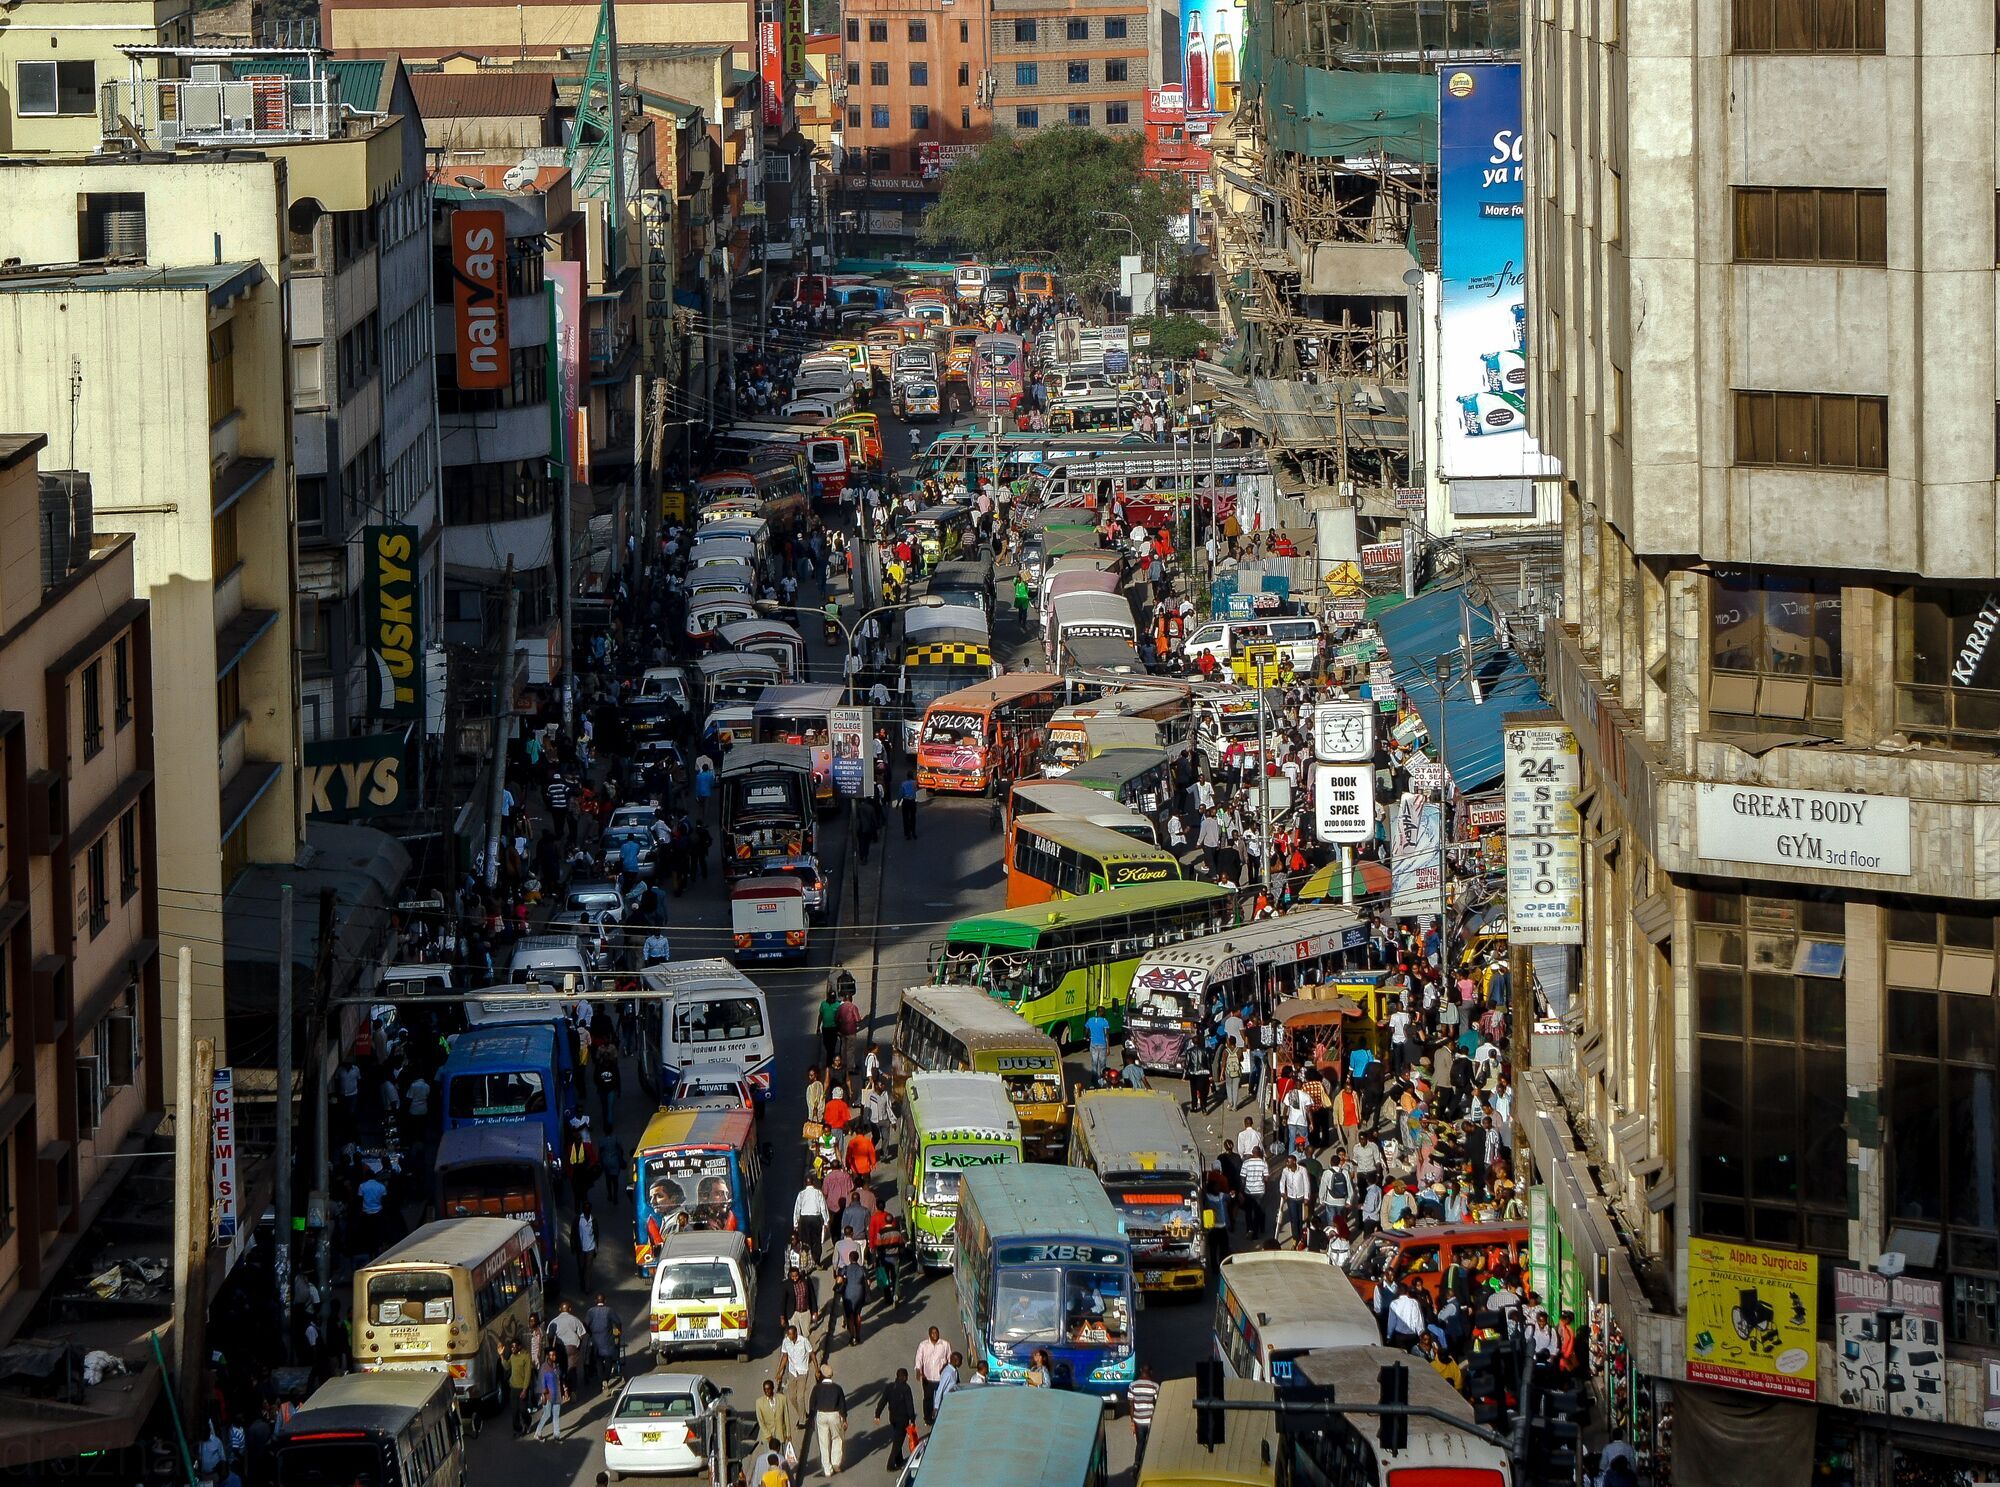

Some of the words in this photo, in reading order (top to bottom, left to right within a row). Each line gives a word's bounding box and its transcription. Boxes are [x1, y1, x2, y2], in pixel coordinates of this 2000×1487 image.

[1482, 168, 1508, 187] ya
[902, 179, 923, 188] PLAZA
[1485, 206, 1508, 215] More
[454, 227, 498, 373] naivas
[1229, 602, 1249, 610] THIKA
[378, 533, 414, 704] TUSKYS
[1067, 628, 1131, 638] MARTIAL
[927, 715, 982, 730] XPLORA
[1519, 757, 1556, 778] 24
[1331, 777, 1357, 787] BOOK
[1333, 790, 1355, 801] THIS
[1330, 805, 1360, 815] SPACE
[1733, 792, 1805, 820] GREAT
[1811, 799, 1869, 826] BODY
[1324, 819, 1339, 827] 0700
[1341, 819, 1352, 827] 060
[1354, 819, 1366, 827] 920
[1532, 785, 1555, 895] STUDIO
[1777, 832, 1824, 860] GYM
[1825, 850, 1847, 865] 3rd
[1849, 851, 1881, 868] floor
[1416, 868, 1438, 876] BRING
[728, 1043, 746, 1051] SACCO
[997, 1056, 1055, 1071] DUST
[697, 1084, 728, 1092] PRIVATE
[215, 1089, 232, 1214] CHEMIST
[651, 1161, 664, 1170] YOU
[669, 1160, 685, 1168] WEAR
[691, 1158, 701, 1167] THE
[701, 1168, 711, 1176] THE
[1042, 1245, 1093, 1263] KBS
[1730, 1249, 1757, 1266] Alpha
[1761, 1254, 1808, 1272] Surgicals
[1710, 1271, 1757, 1283] WHOLESALE
[1766, 1279, 1793, 1289] RETAIL
[1893, 1279, 1941, 1306] Depot
[673, 1329, 700, 1340] MADIWA
[702, 1329, 724, 1339] SACCO
[1692, 1364, 1729, 1375] INTERFINA
[1705, 1372, 1719, 1380] 020
